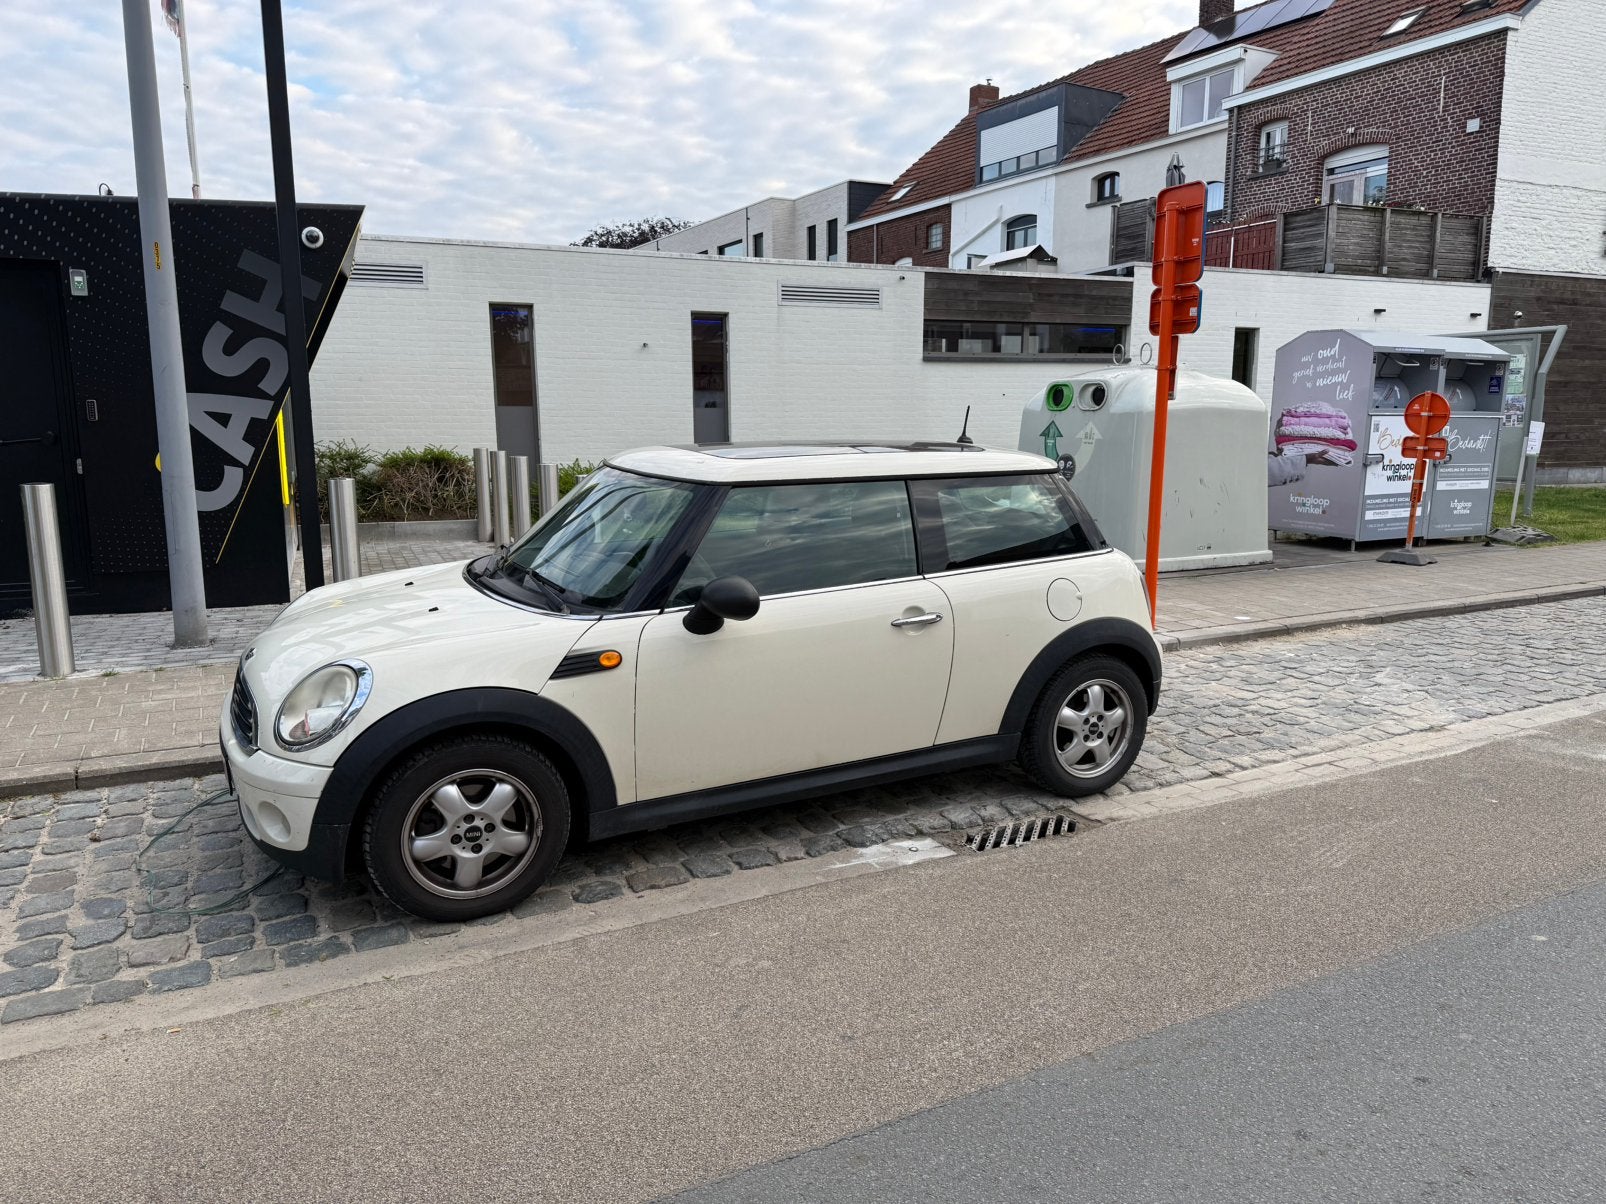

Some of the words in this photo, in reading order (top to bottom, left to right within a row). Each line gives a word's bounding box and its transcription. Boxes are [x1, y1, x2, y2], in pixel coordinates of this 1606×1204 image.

[1318, 339, 1340, 359] oud
[1317, 356, 1346, 372] verdient
[1316, 370, 1351, 387] nieuw
[1336, 384, 1356, 401] lief
[1382, 461, 1415, 474] kringloop
[1386, 472, 1409, 482] winkel
[1289, 493, 1330, 508] kringloop
[1295, 505, 1322, 515] winkel
